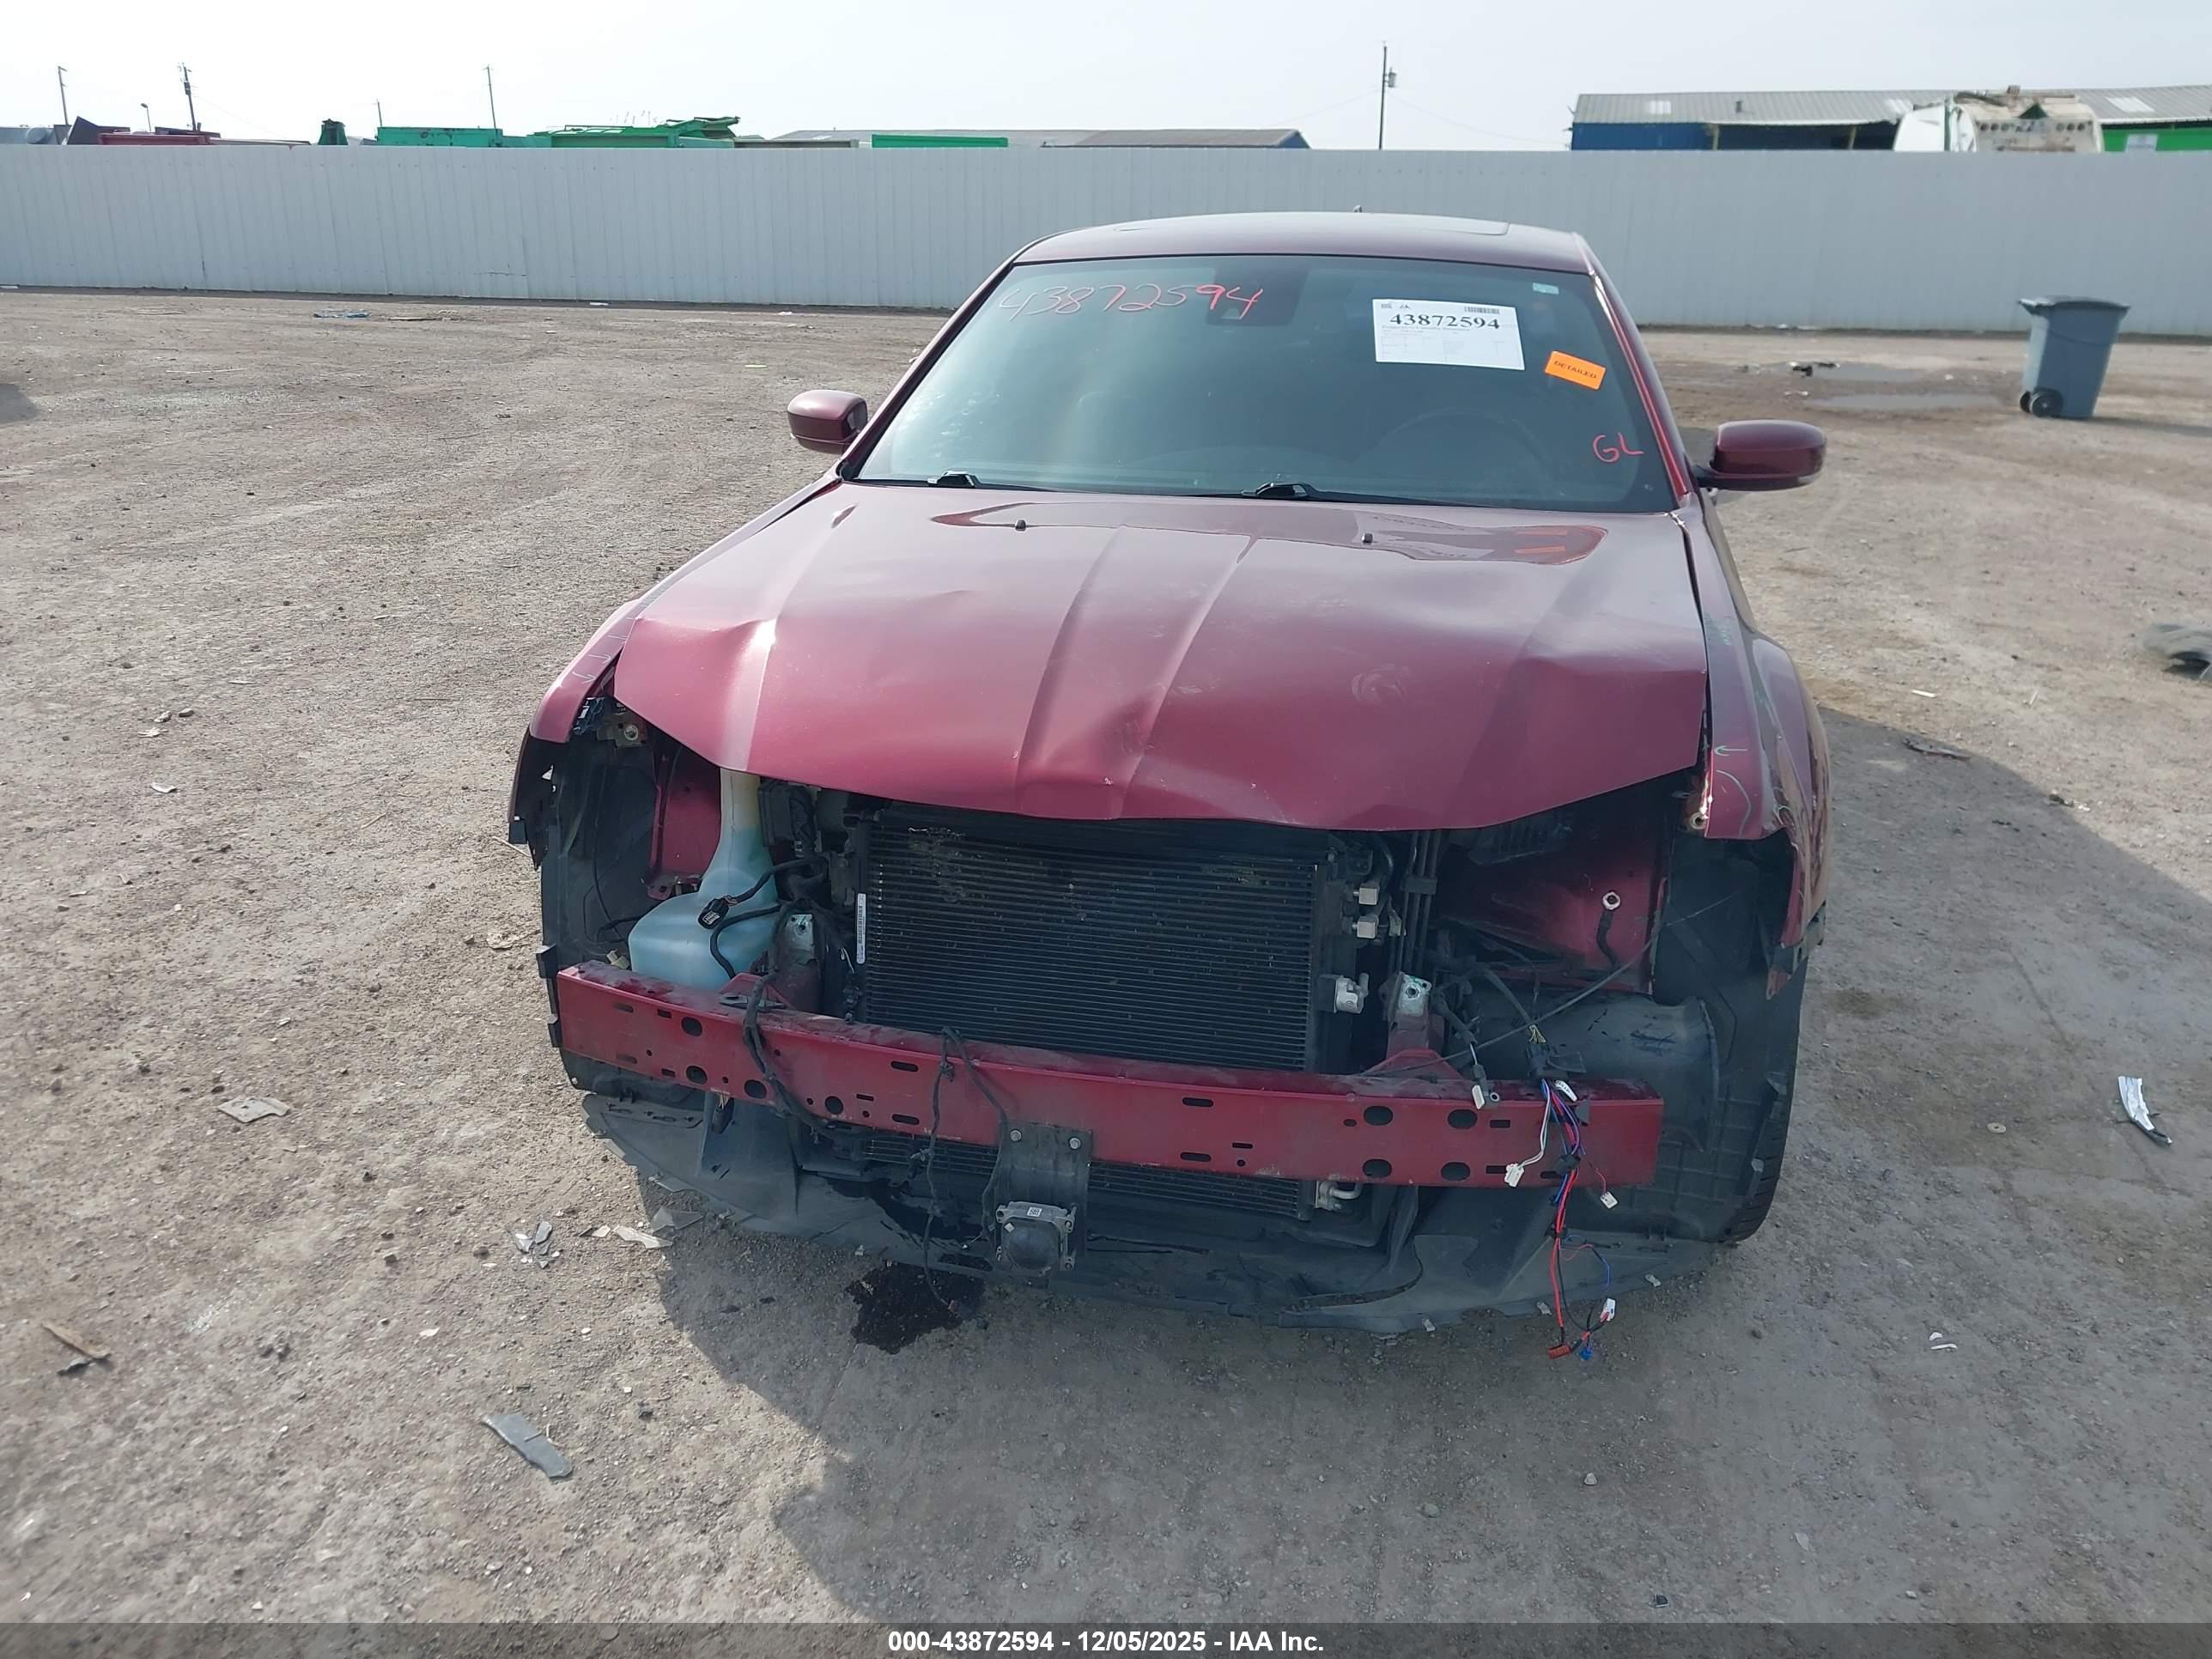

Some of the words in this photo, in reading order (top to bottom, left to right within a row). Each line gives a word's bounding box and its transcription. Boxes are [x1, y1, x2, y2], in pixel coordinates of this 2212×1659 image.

[999, 283, 1263, 321] 43872594
[1389, 313, 1501, 330] 43872594
[1553, 361, 1598, 379] DETAILED
[1593, 432, 1644, 463] GL
